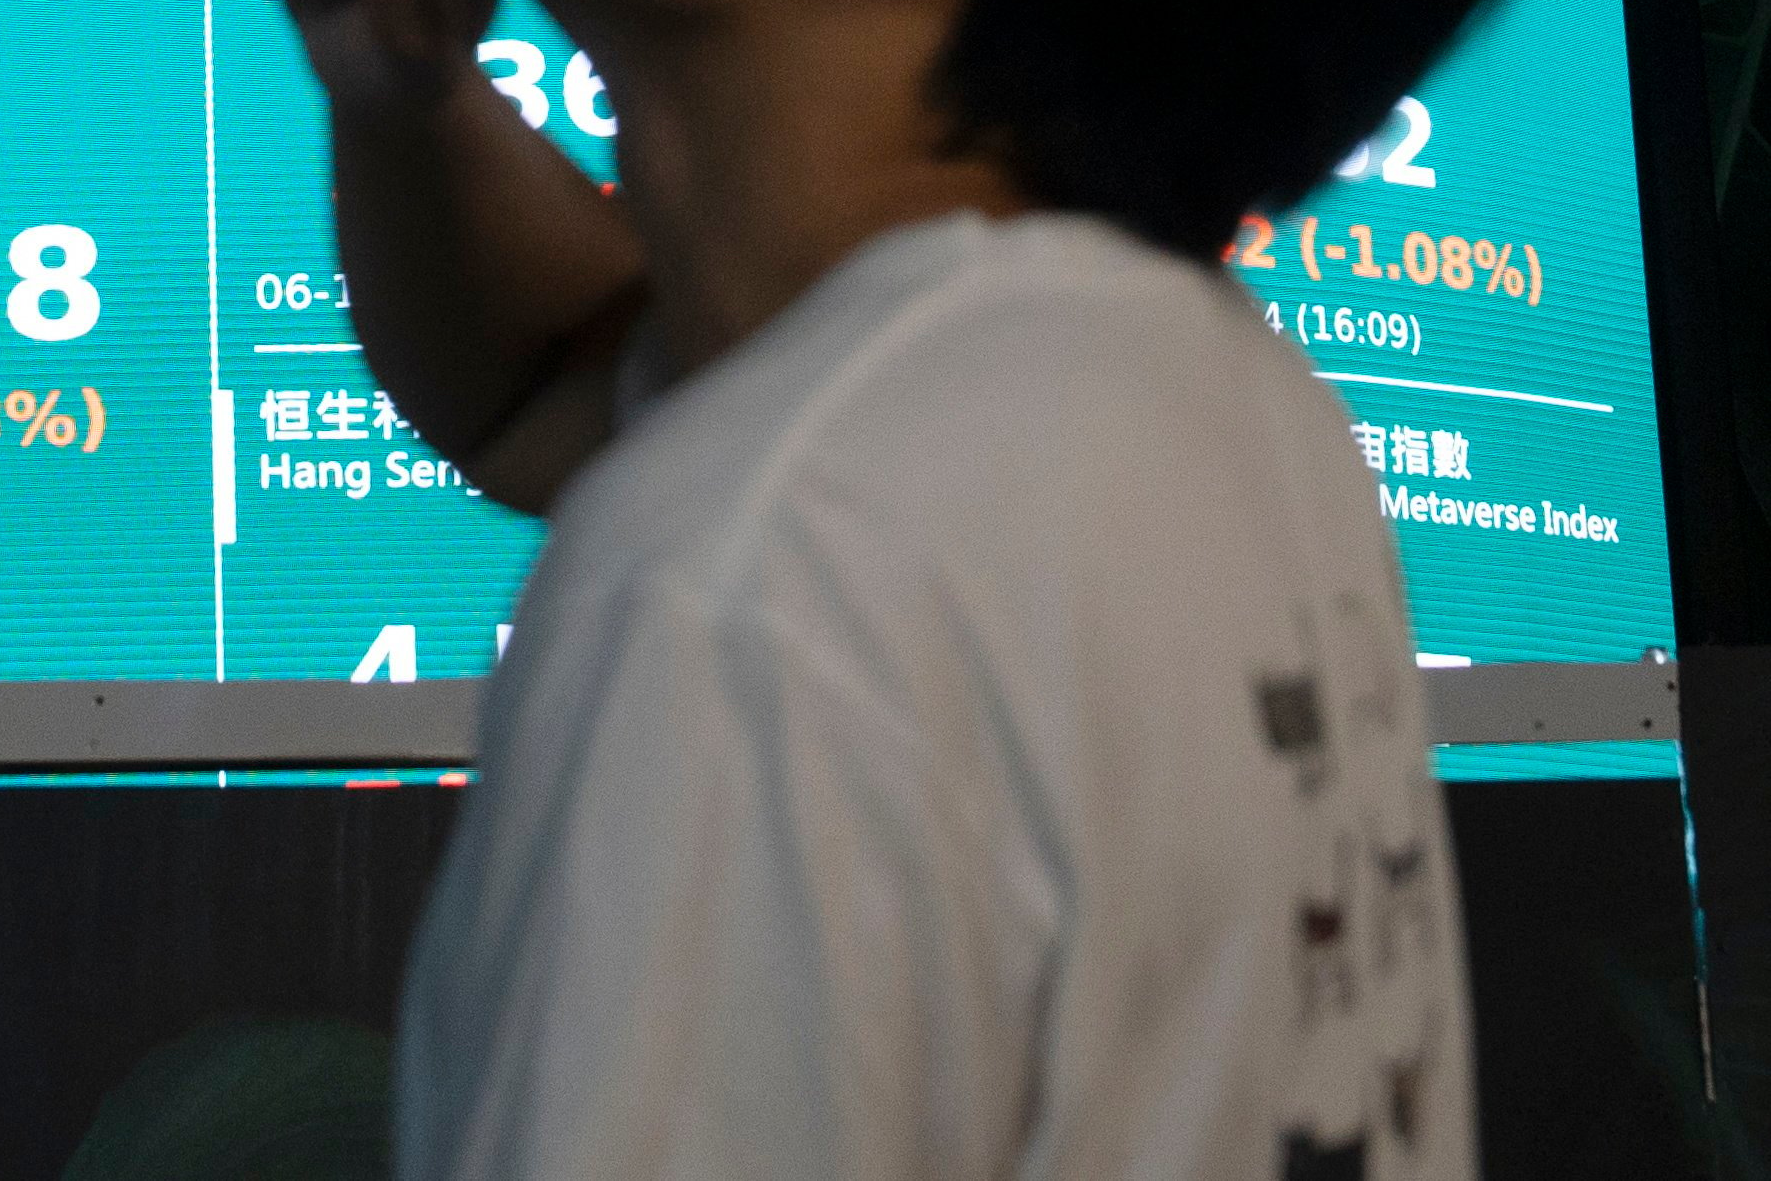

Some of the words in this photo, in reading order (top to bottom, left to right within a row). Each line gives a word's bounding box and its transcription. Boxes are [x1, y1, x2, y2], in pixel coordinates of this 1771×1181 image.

[1300, 216, 1542, 306] (-1.08%)
[256, 272, 352, 311] 06-1
[1264, 301, 1284, 335] 4
[1297, 303, 1422, 356] (16:09)
[260, 453, 371, 499] Hang
[386, 451, 482, 497] Sen
[1379, 483, 1536, 532] Metaverse
[1542, 500, 1620, 543] Index
